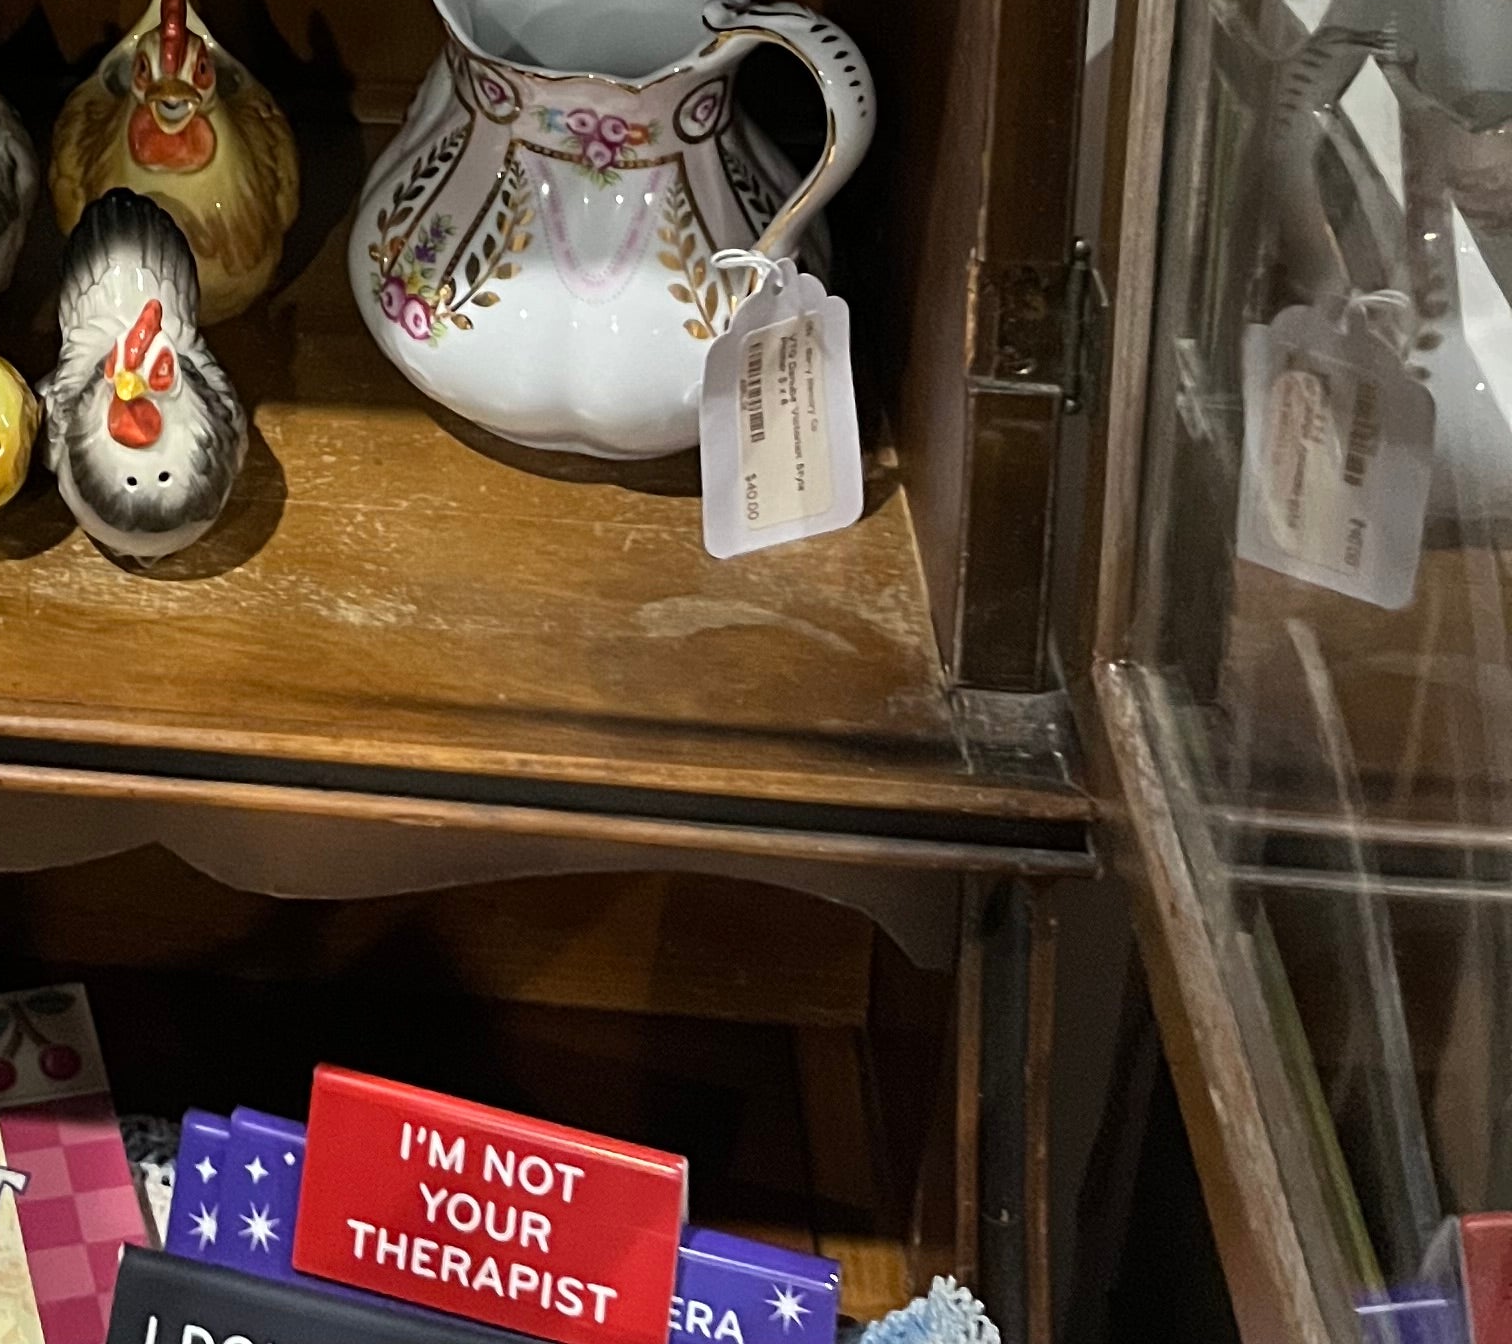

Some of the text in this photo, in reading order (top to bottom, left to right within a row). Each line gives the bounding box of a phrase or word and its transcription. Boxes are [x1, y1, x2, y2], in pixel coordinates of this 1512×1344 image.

[399, 1121, 586, 1204] I'M NOT
[419, 1181, 553, 1254] YOUR
[346, 1218, 619, 1325] THERAPIST
